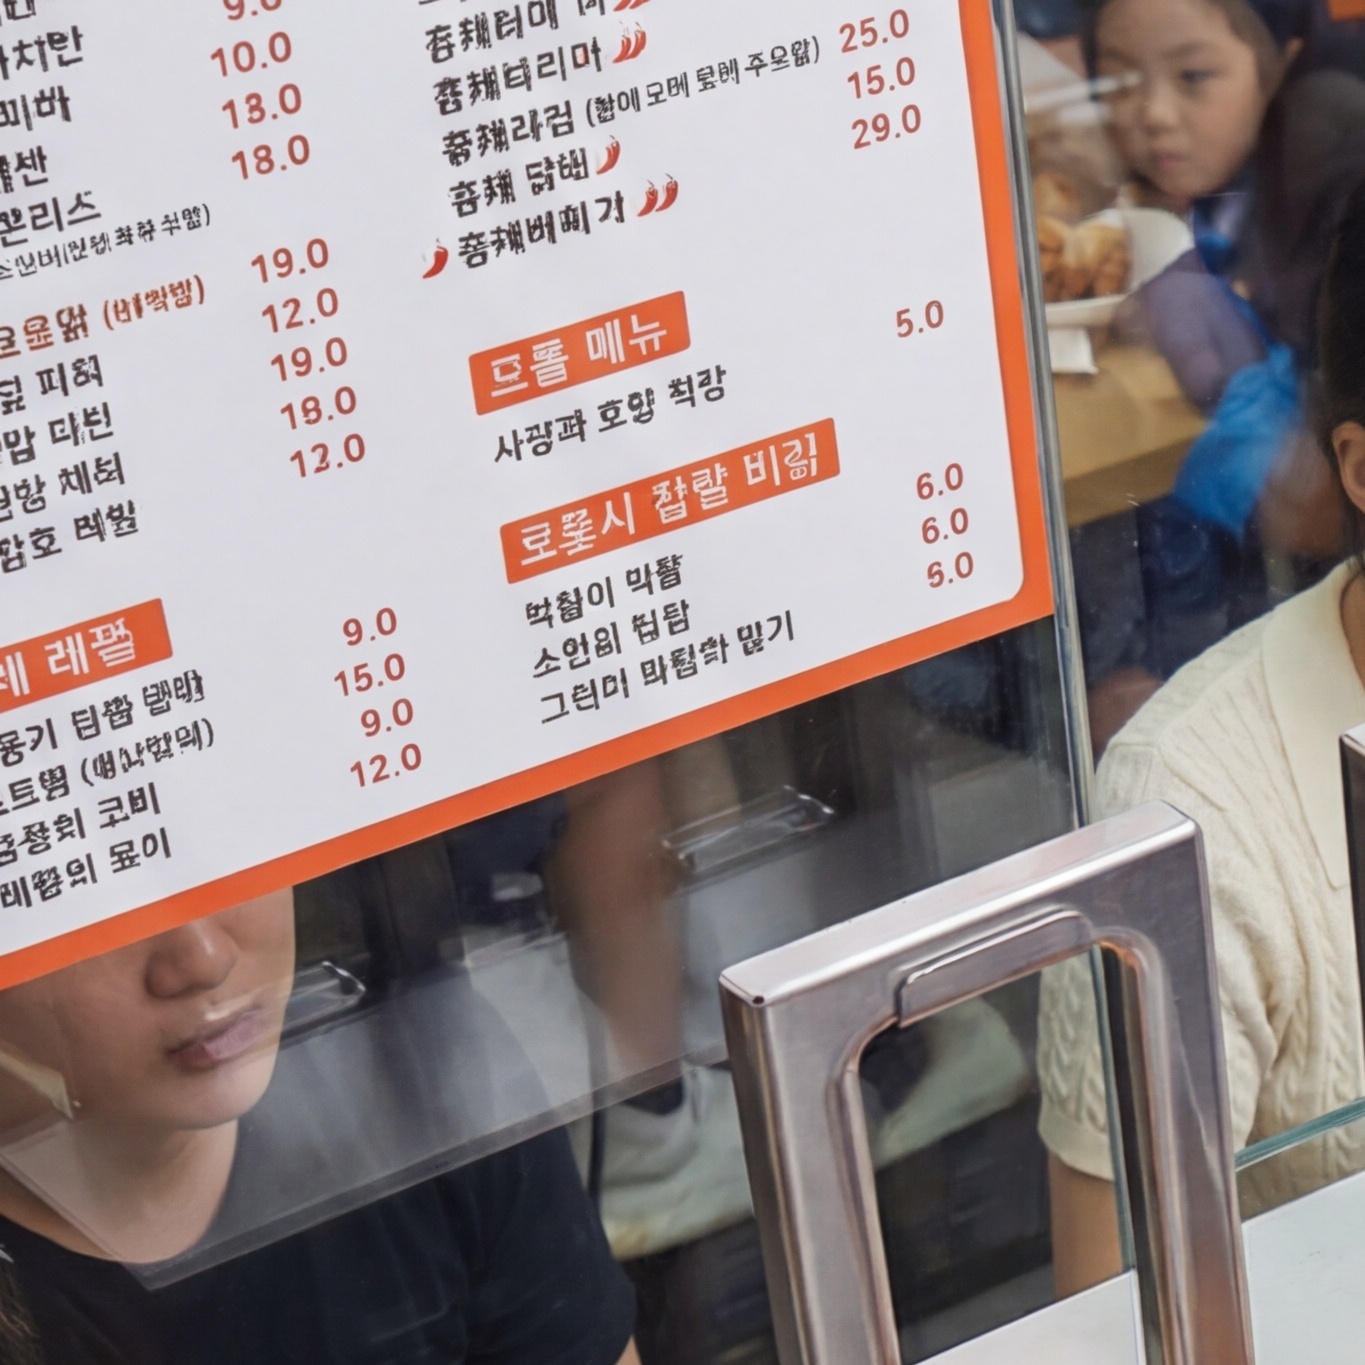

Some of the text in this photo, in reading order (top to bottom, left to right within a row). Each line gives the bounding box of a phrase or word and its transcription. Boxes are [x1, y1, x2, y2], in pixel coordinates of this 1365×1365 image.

[839, 9, 909, 53] 25.0
[210, 31, 292, 77] 10.0
[848, 57, 915, 99] 15.0
[852, 104, 921, 149] 29.0
[232, 135, 310, 180] 18.0
[251, 238, 329, 283] 19.0
[262, 288, 338, 333] 12.0
[897, 300, 943, 337] 5.0
[271, 337, 347, 381] 19.0
[586, 315, 666, 363] 메뉴
[290, 433, 365, 477] 12.0
[917, 463, 963, 500] 6.0
[922, 508, 968, 544] 6.0
[343, 608, 397, 646] 9.0
[335, 653, 405, 696] 15.0
[361, 698, 413, 737] 9.0
[351, 743, 421, 787] 12.0
